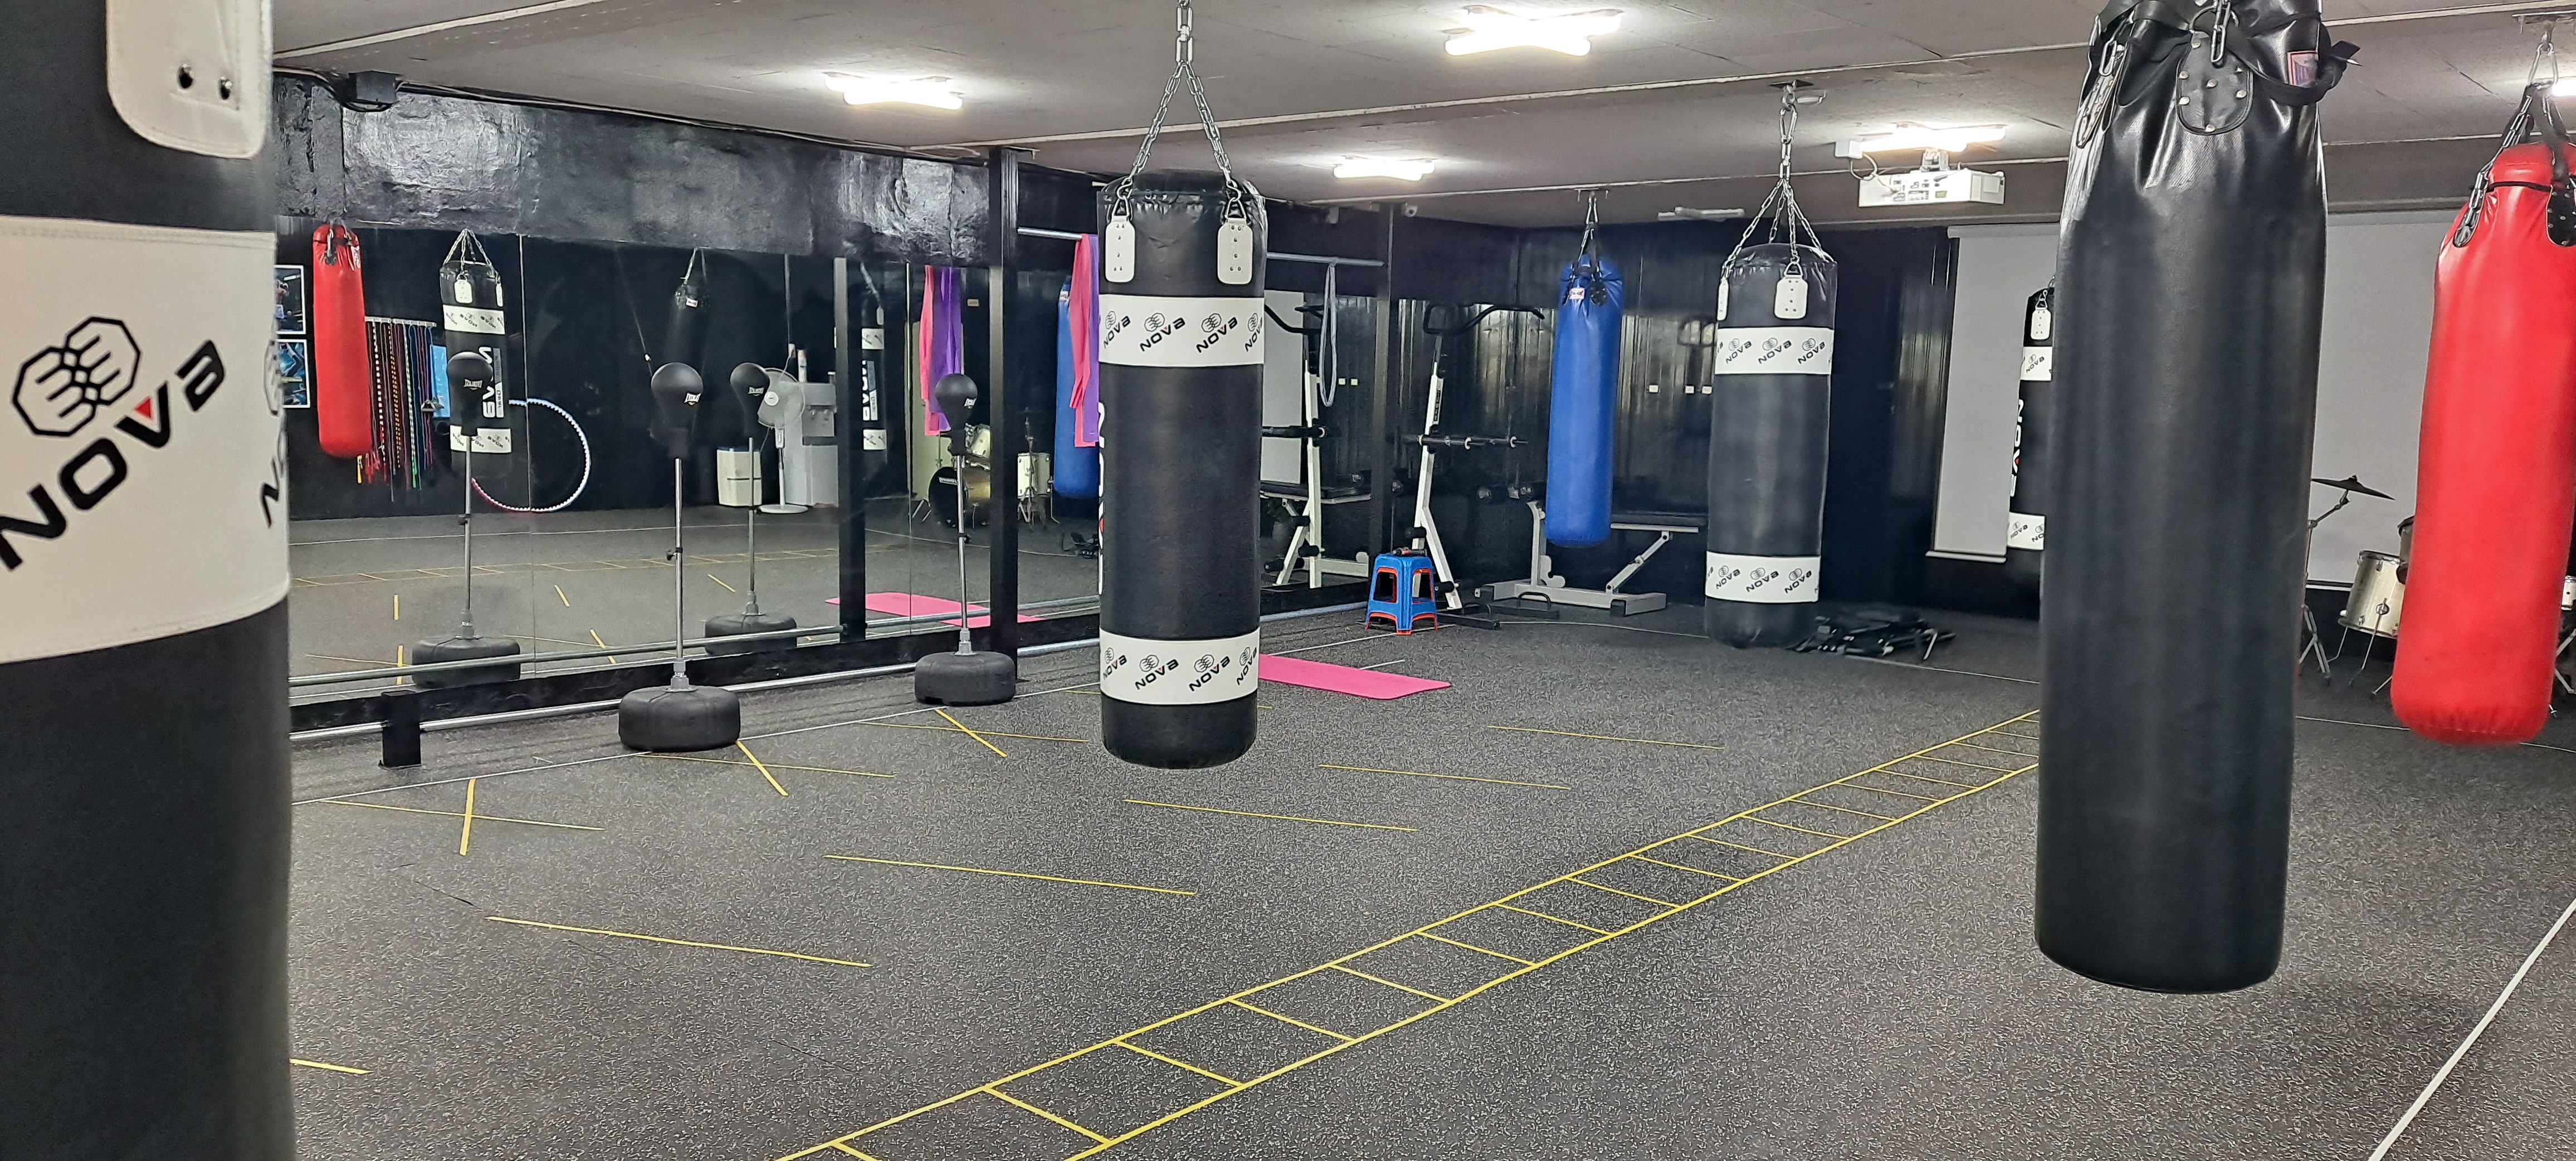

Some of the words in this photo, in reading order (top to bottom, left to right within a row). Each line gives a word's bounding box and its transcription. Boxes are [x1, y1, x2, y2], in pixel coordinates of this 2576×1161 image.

[1104, 315, 1131, 349] NOVA
[1139, 317, 1186, 352] NOVA
[1196, 316, 1238, 353] NOVA
[1726, 341, 1752, 364] NOVA
[1758, 340, 1792, 364] NOVA
[1798, 342, 1826, 364] NOVA
[2026, 357, 2045, 373] NOVA
[0, 340, 225, 570] NOVA
[1716, 569, 1740, 589] NOVA
[1746, 571, 1779, 592] NOVA
[1784, 570, 1812, 593] NOVA
[1103, 655, 1127, 681] NOVA
[1135, 659, 1179, 690] NOVA
[1189, 656, 1230, 691] NOVA
[1237, 647, 1257, 685] NOVA
